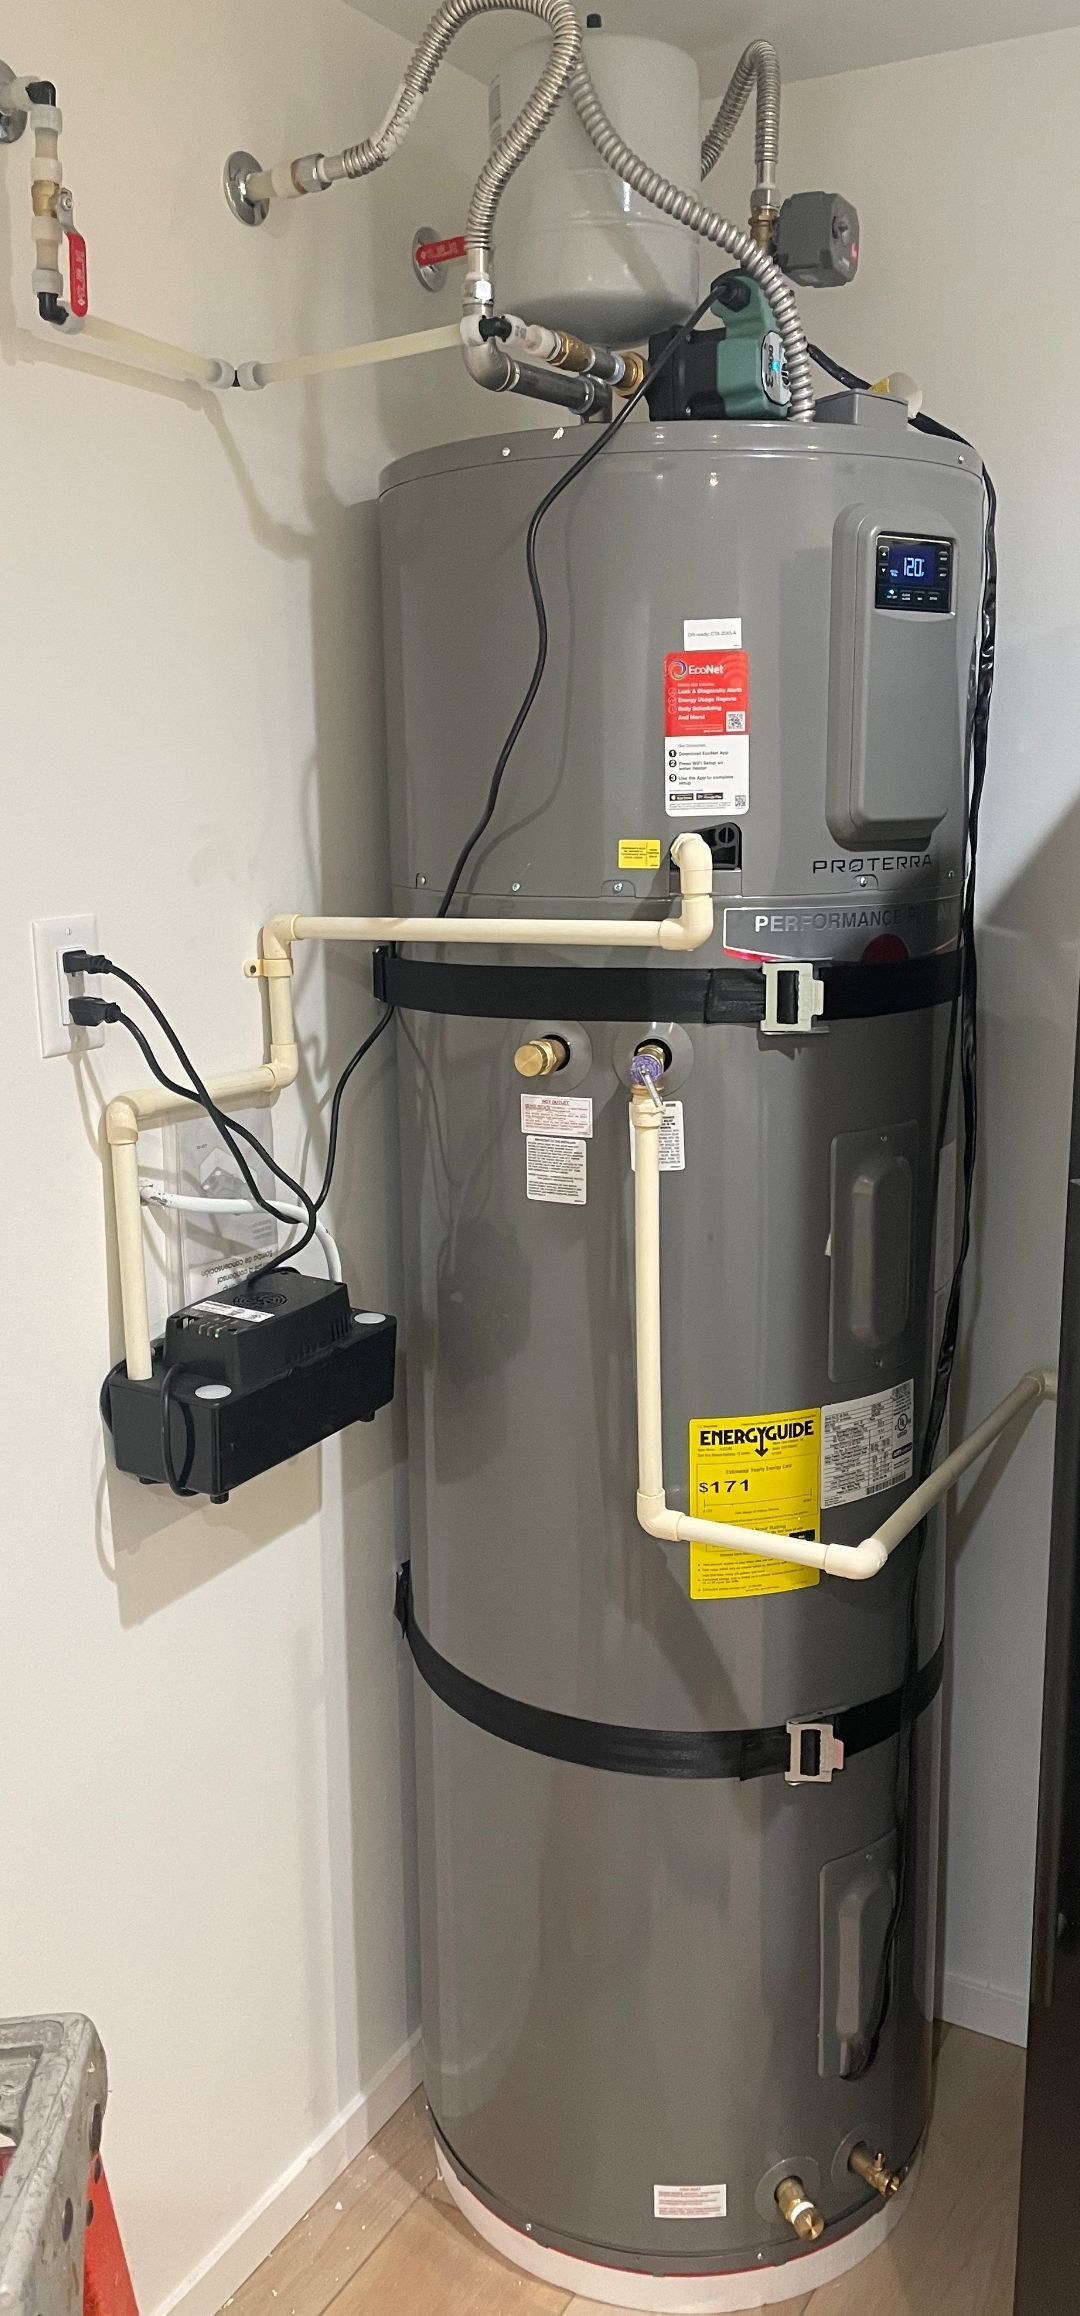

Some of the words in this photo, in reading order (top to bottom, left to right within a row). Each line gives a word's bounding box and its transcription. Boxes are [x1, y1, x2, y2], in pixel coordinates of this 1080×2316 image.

[688, 664, 724, 675] EcoNet
[697, 687, 726, 695] Diagnostic
[812, 853, 932, 874] PROTERRA
[754, 909, 903, 933] PERFORMANCE
[700, 1419, 815, 1447] ENERGYGUIDE
[698, 1479, 749, 1494] $171
